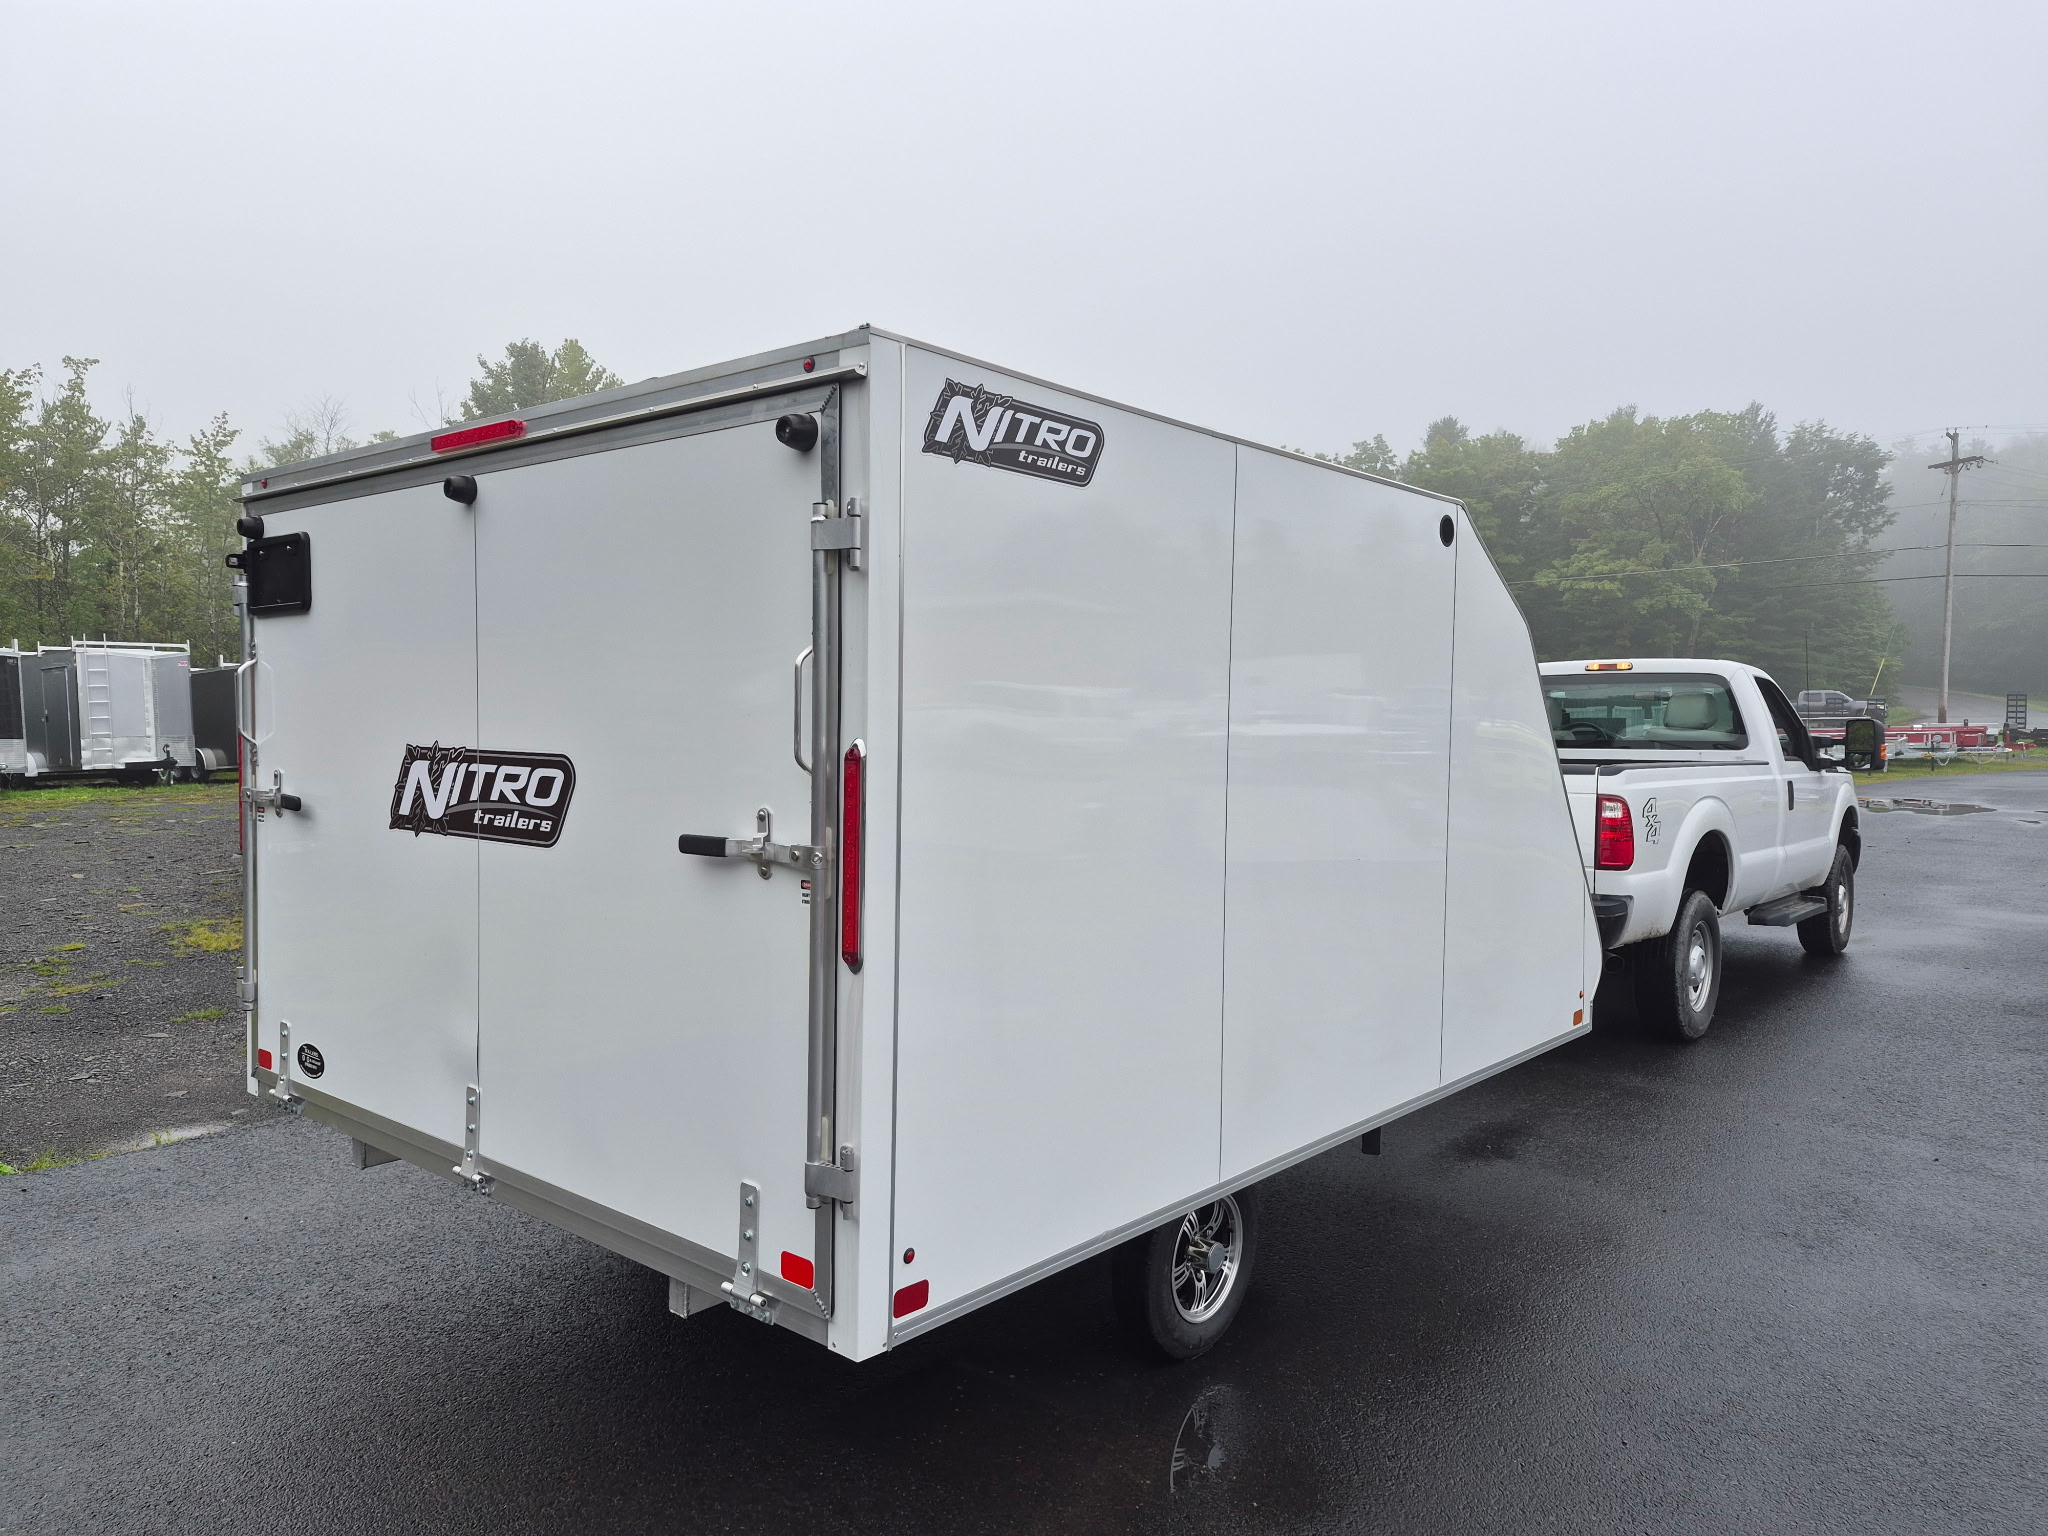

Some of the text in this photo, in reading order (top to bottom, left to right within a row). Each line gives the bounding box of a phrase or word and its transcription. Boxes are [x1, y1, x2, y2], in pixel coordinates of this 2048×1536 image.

[934, 395, 1096, 458] NITRO
[1018, 450, 1086, 476] trailers
[399, 760, 565, 820] NITRO
[474, 810, 553, 832] trailers
